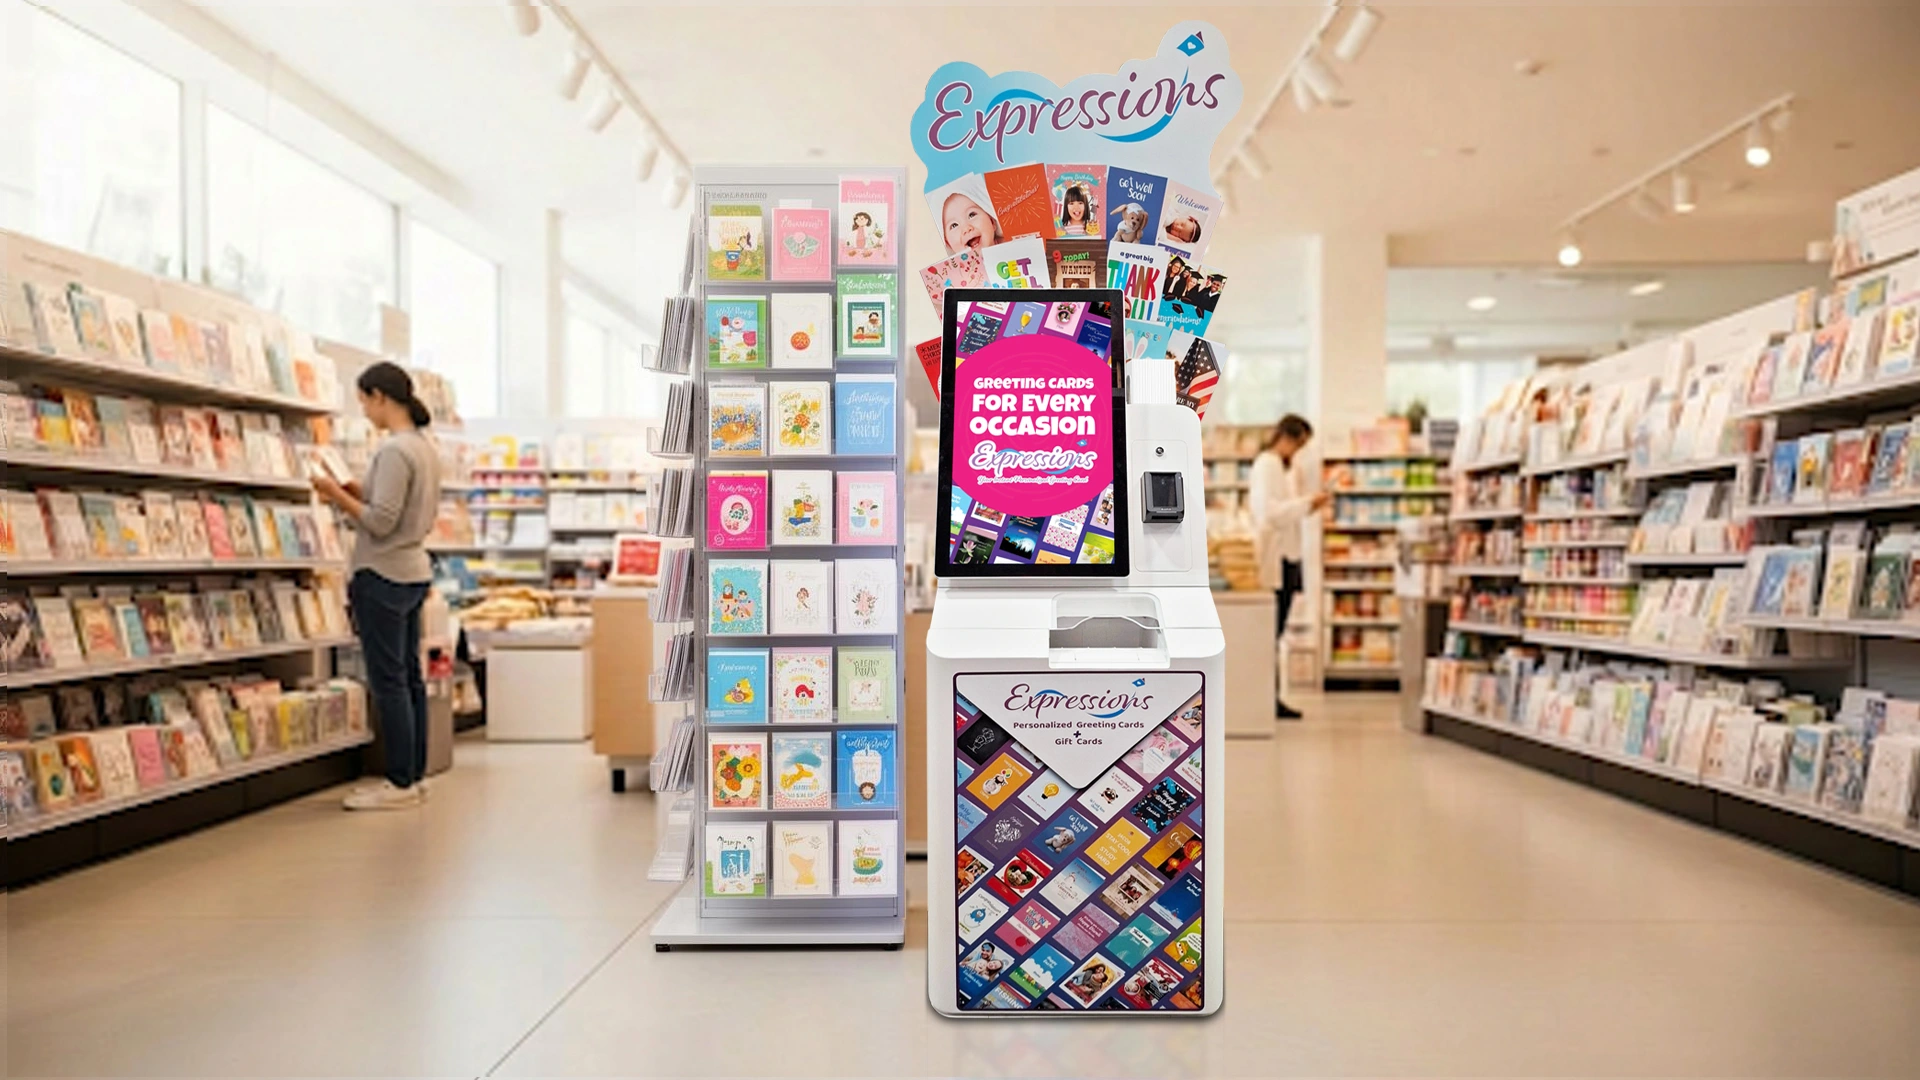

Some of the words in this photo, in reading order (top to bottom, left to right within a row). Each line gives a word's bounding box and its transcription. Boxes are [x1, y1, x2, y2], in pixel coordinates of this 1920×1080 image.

[928, 72, 1226, 164] Expressions
[1118, 176, 1134, 188] Get
[1127, 187, 1147, 202] Soon
[1175, 193, 1210, 212] Welcome
[1052, 249, 1062, 263] 9
[1063, 252, 1090, 262] TODAY!
[1125, 252, 1143, 261] great
[1143, 255, 1154, 264] big
[996, 257, 1031, 280] GET
[1061, 265, 1092, 276] WANTED
[1107, 259, 1160, 301] THANK
[1048, 377, 1094, 389] CARDS
[972, 393, 1018, 412] FOR
[970, 441, 1097, 476] Expressions
[1004, 683, 1154, 719] Expressions
[1013, 721, 1073, 729] Personalized
[1076, 721, 1116, 730] Greeting
[1118, 721, 1145, 729] Cards
[1105, 833, 1119, 846] STAY
[1117, 842, 1132, 857] COOL
[1095, 852, 1111, 867] HARD
[1099, 846, 1117, 862] STUDY
[1023, 917, 1042, 931] YOU
[1025, 905, 1052, 929] THANK
